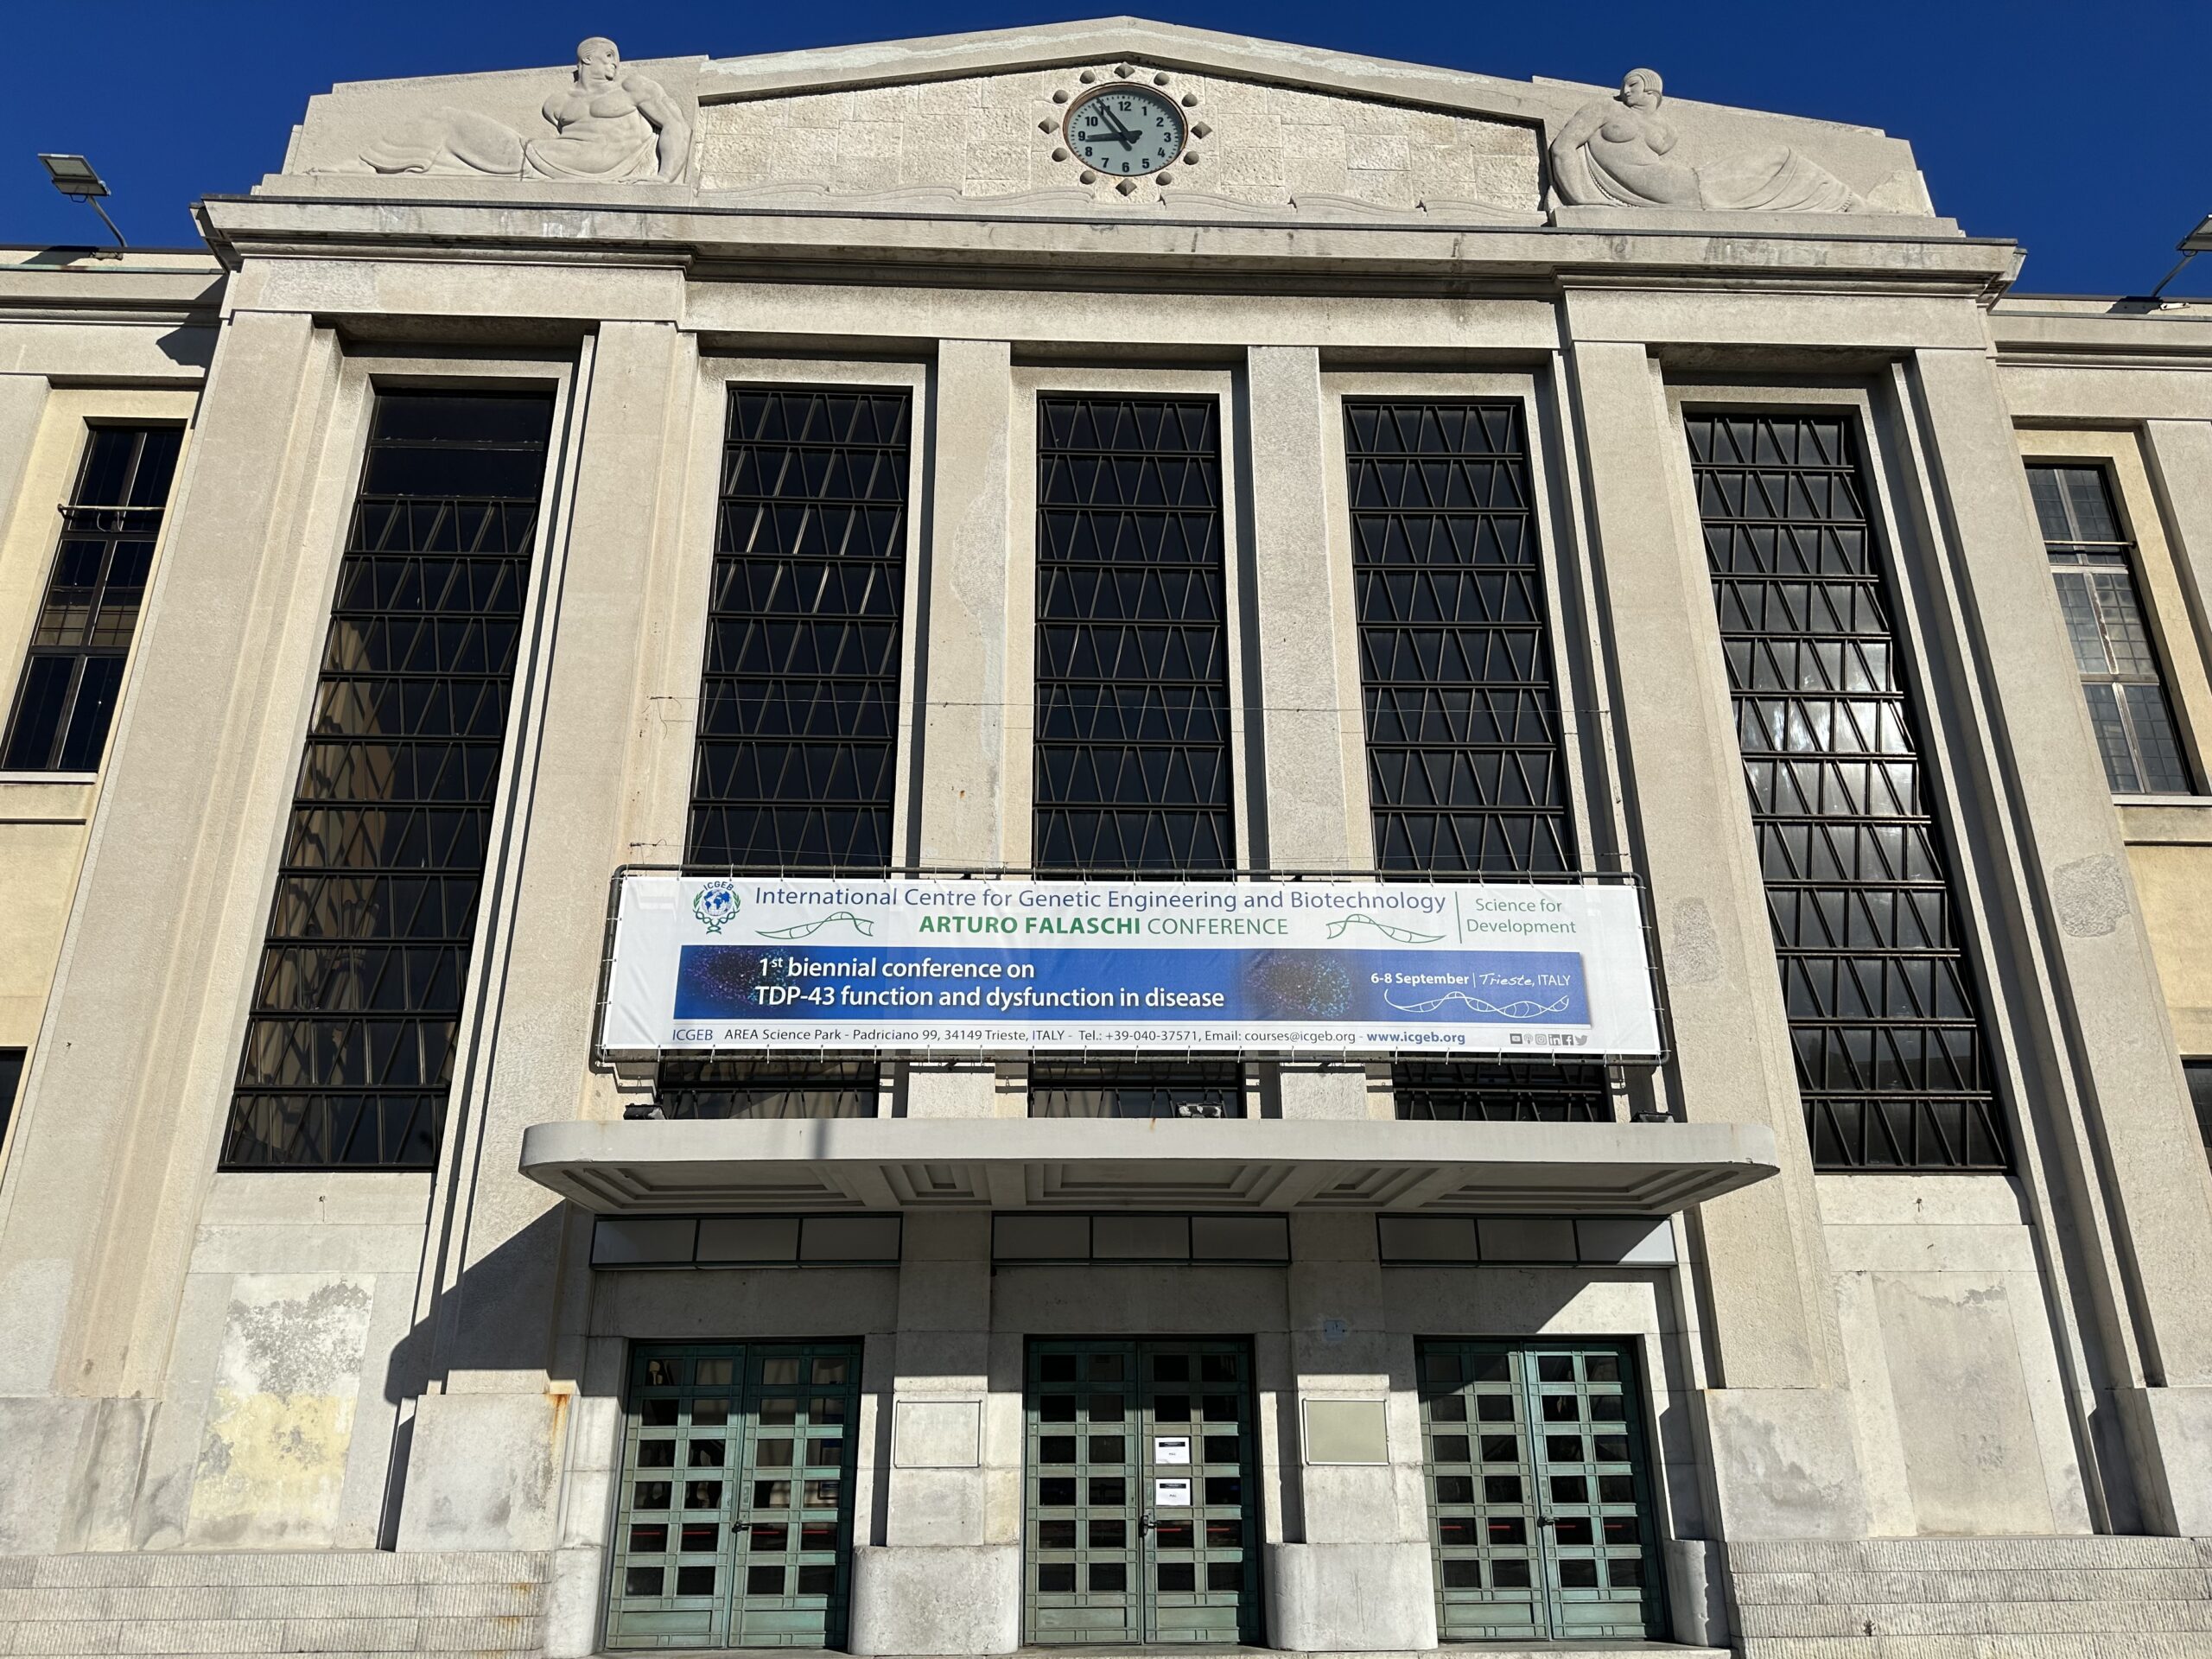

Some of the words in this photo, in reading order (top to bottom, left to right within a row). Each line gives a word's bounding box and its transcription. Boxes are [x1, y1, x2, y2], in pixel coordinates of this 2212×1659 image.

[1118, 101, 1132, 111] 12
[1141, 106, 1147, 116] 1
[1085, 117, 1098, 126] 10
[1156, 118, 1164, 127] 2
[1077, 131, 1086, 141] 9
[1164, 133, 1172, 143] 3
[1085, 147, 1093, 156] 8
[1158, 147, 1166, 157] 4
[1102, 158, 1109, 168] 7
[1123, 162, 1129, 172] 6
[1142, 159, 1150, 168] 5
[703, 880, 734, 892] ICGEB
[755, 887, 897, 906] International
[905, 888, 976, 906] Centre
[983, 888, 1012, 906] for
[1019, 889, 1101, 907] Genetic
[1109, 890, 1236, 912] Engineering
[1244, 891, 1283, 908] and
[1291, 891, 1446, 913] Biotechnology
[1476, 898, 1535, 912] Science
[1540, 898, 1562, 912] for
[919, 916, 1018, 934] ARTURO
[1026, 917, 1140, 934] FALASCHI
[1147, 918, 1288, 935] CONFERENCE
[1466, 918, 1576, 936] Development
[787, 957, 876, 977] biennial
[882, 957, 1001, 978] conference
[1007, 963, 1034, 978] on
[1370, 973, 1393, 983] 6-8
[1395, 973, 1469, 986] September
[1479, 973, 1535, 988] Trieste,
[1538, 975, 1571, 986] ITALY
[754, 985, 835, 1006] TDP-43
[841, 985, 933, 1006] function
[938, 986, 980, 1007] and
[986, 986, 1114, 1012] dysfunction
[1120, 988, 1140, 1007] in
[1145, 987, 1224, 1007] disease
[672, 1029, 713, 1041] ICGEB
[724, 1029, 759, 1039] AREA
[762, 1029, 810, 1040] Science
[814, 1029, 841, 1039] Park
[853, 1029, 918, 1040] Padriciano
[922, 1030, 940, 1041] 99,
[944, 1030, 982, 1040] 34149
[984, 1030, 1028, 1041] Trieste,
[1033, 1030, 1065, 1040] ITALY
[1078, 1030, 1103, 1041] Tel.:
[1105, 1030, 1201, 1042] +39-040-37571,
[1205, 1031, 1242, 1041] Email:
[1244, 1031, 1356, 1044] courses@icgeb.org
[1367, 1032, 1465, 1045] www.icgeb.org
